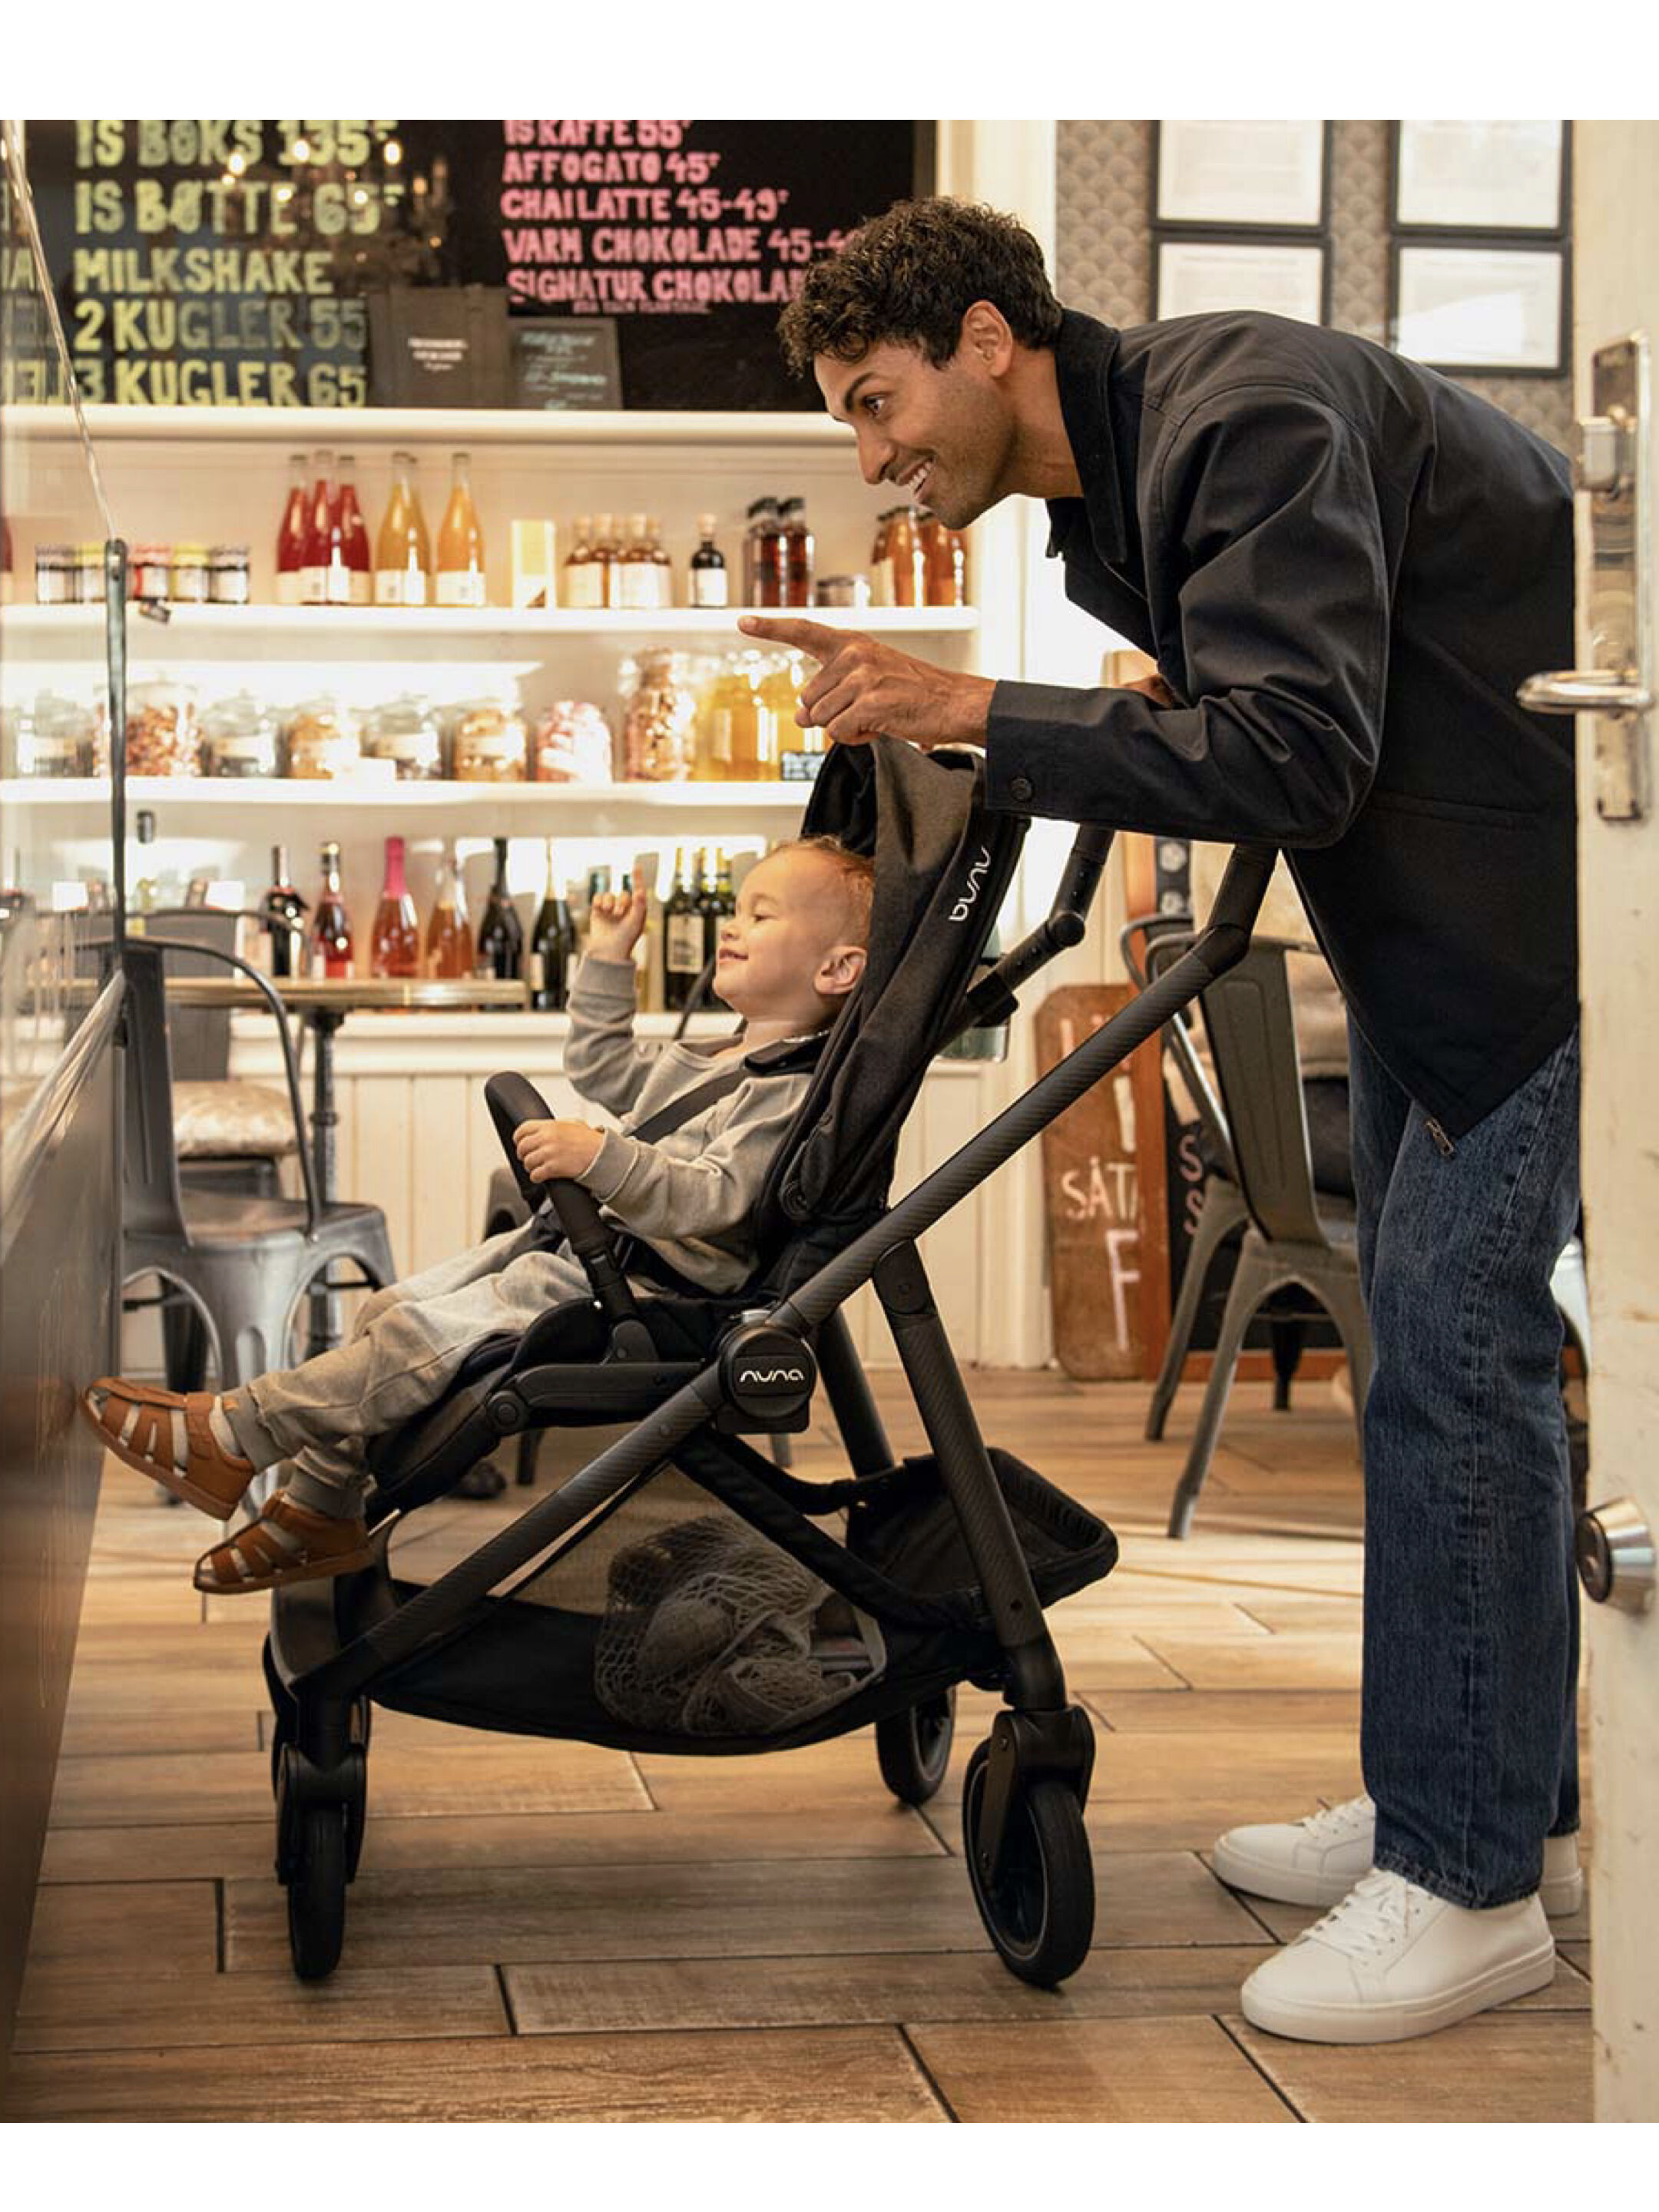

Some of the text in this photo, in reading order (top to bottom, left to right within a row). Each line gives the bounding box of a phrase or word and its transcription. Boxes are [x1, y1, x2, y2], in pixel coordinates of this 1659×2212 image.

[76, 120, 124, 167] IS
[502, 150, 661, 183] AFFOGATO
[75, 180, 124, 233] IS
[502, 227, 582, 263] VARM
[591, 227, 762, 263] CHOKOLADE
[74, 248, 333, 293] MILKSHAKE
[507, 270, 647, 303] SIGNATUR
[75, 299, 105, 351] 2
[114, 299, 303, 351] KUGLER
[310, 298, 366, 350] 55
[114, 359, 303, 406] KUGLER
[309, 363, 366, 407] 65
[739, 1369, 805, 1382] nuna
